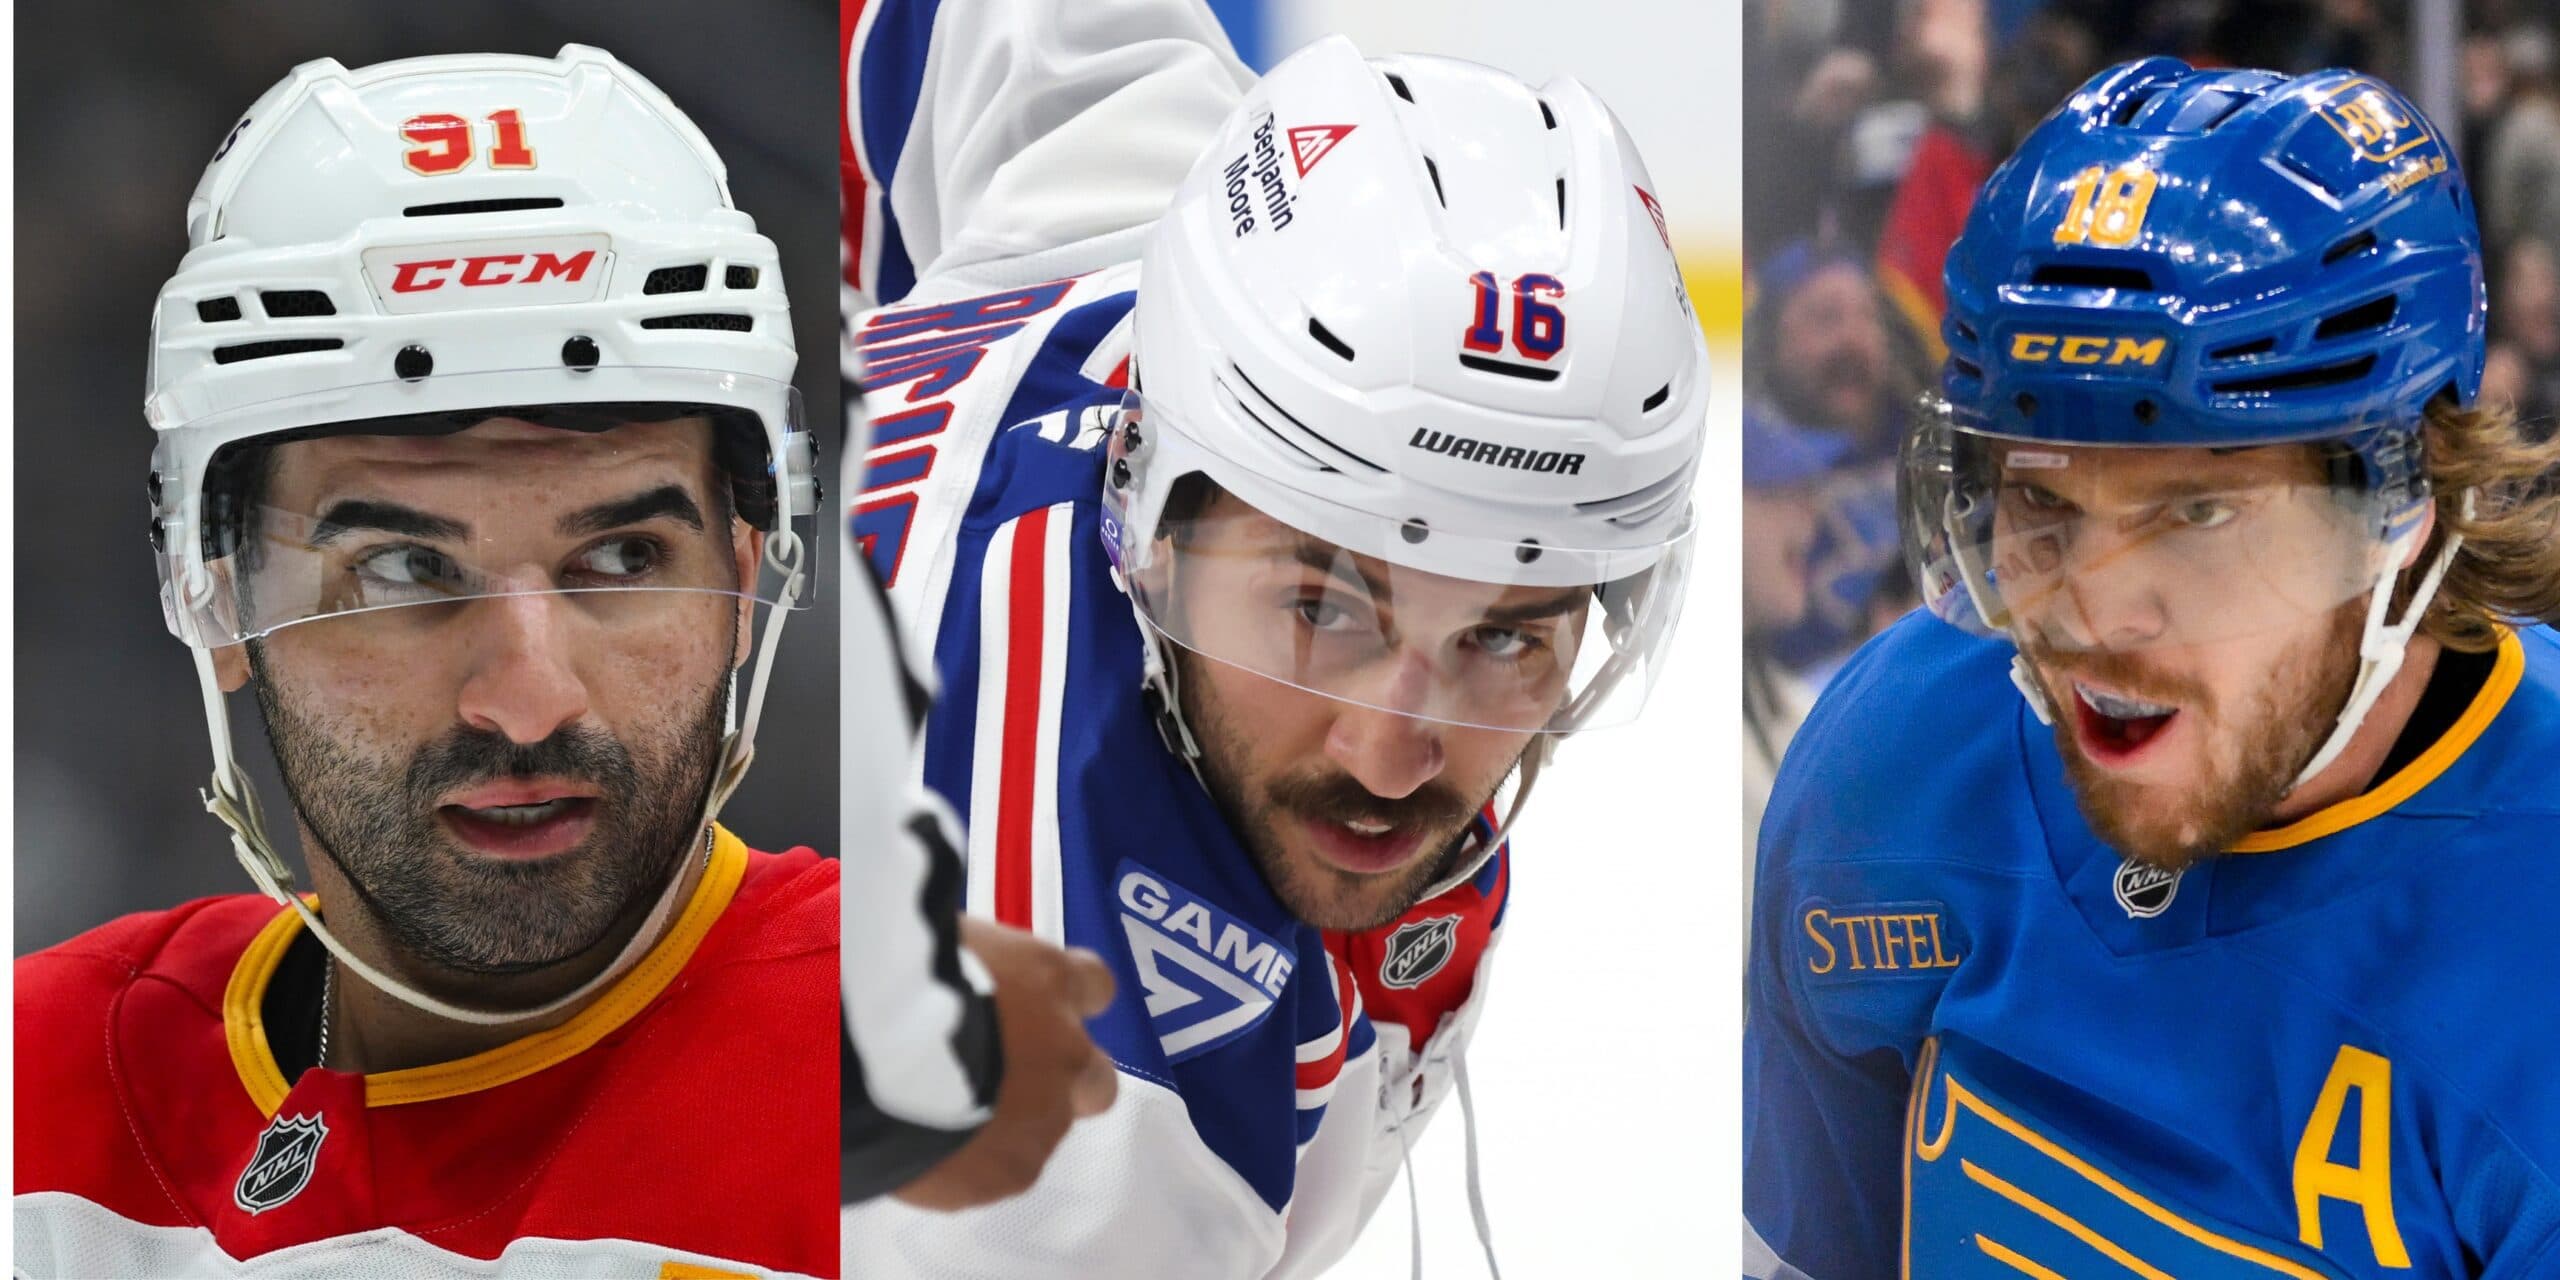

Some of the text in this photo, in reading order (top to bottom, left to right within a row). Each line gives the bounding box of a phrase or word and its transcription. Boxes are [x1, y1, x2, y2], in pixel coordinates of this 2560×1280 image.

[400, 108, 537, 177] 91
[1251, 111, 1299, 232] Benjamin
[1224, 152, 1255, 238] Moore
[2053, 163, 2160, 249] 18
[391, 250, 597, 294] CCM
[1463, 270, 1567, 362] 16
[2010, 332, 2167, 366] CCM
[1408, 427, 1586, 475] WARRIOR
[1118, 871, 1293, 1000] GAME
[1397, 928, 1442, 977] NHL
[1804, 909, 1960, 974] STIFEL
[250, 1142, 305, 1194] NHL
[2292, 1043, 2412, 1269] A
